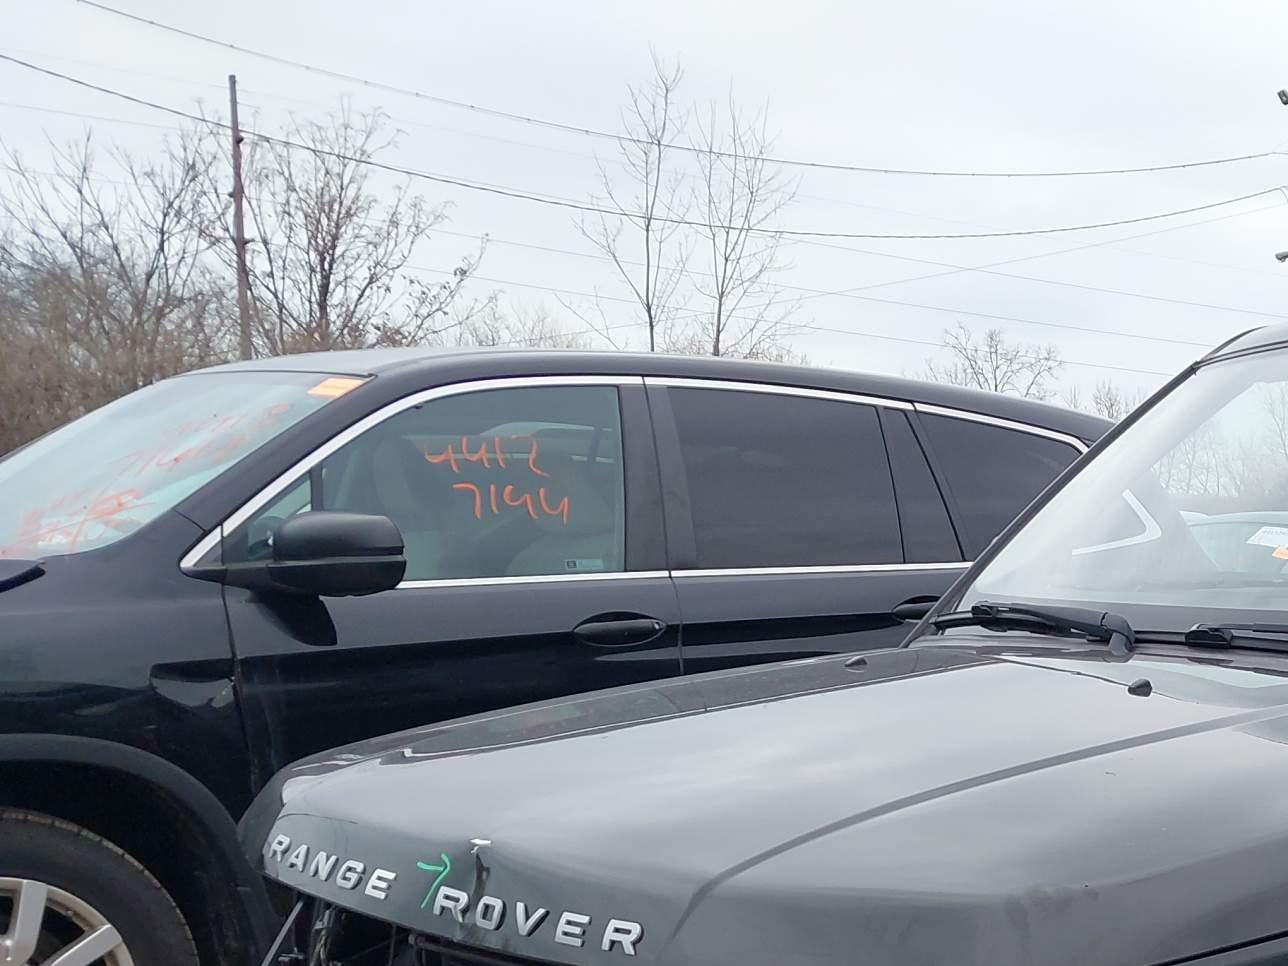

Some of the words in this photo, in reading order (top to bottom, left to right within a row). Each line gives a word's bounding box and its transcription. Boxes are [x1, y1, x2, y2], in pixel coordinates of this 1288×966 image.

[424, 435, 550, 477] 4412
[266, 833, 397, 900] RANGE
[432, 885, 644, 956] ROVER
